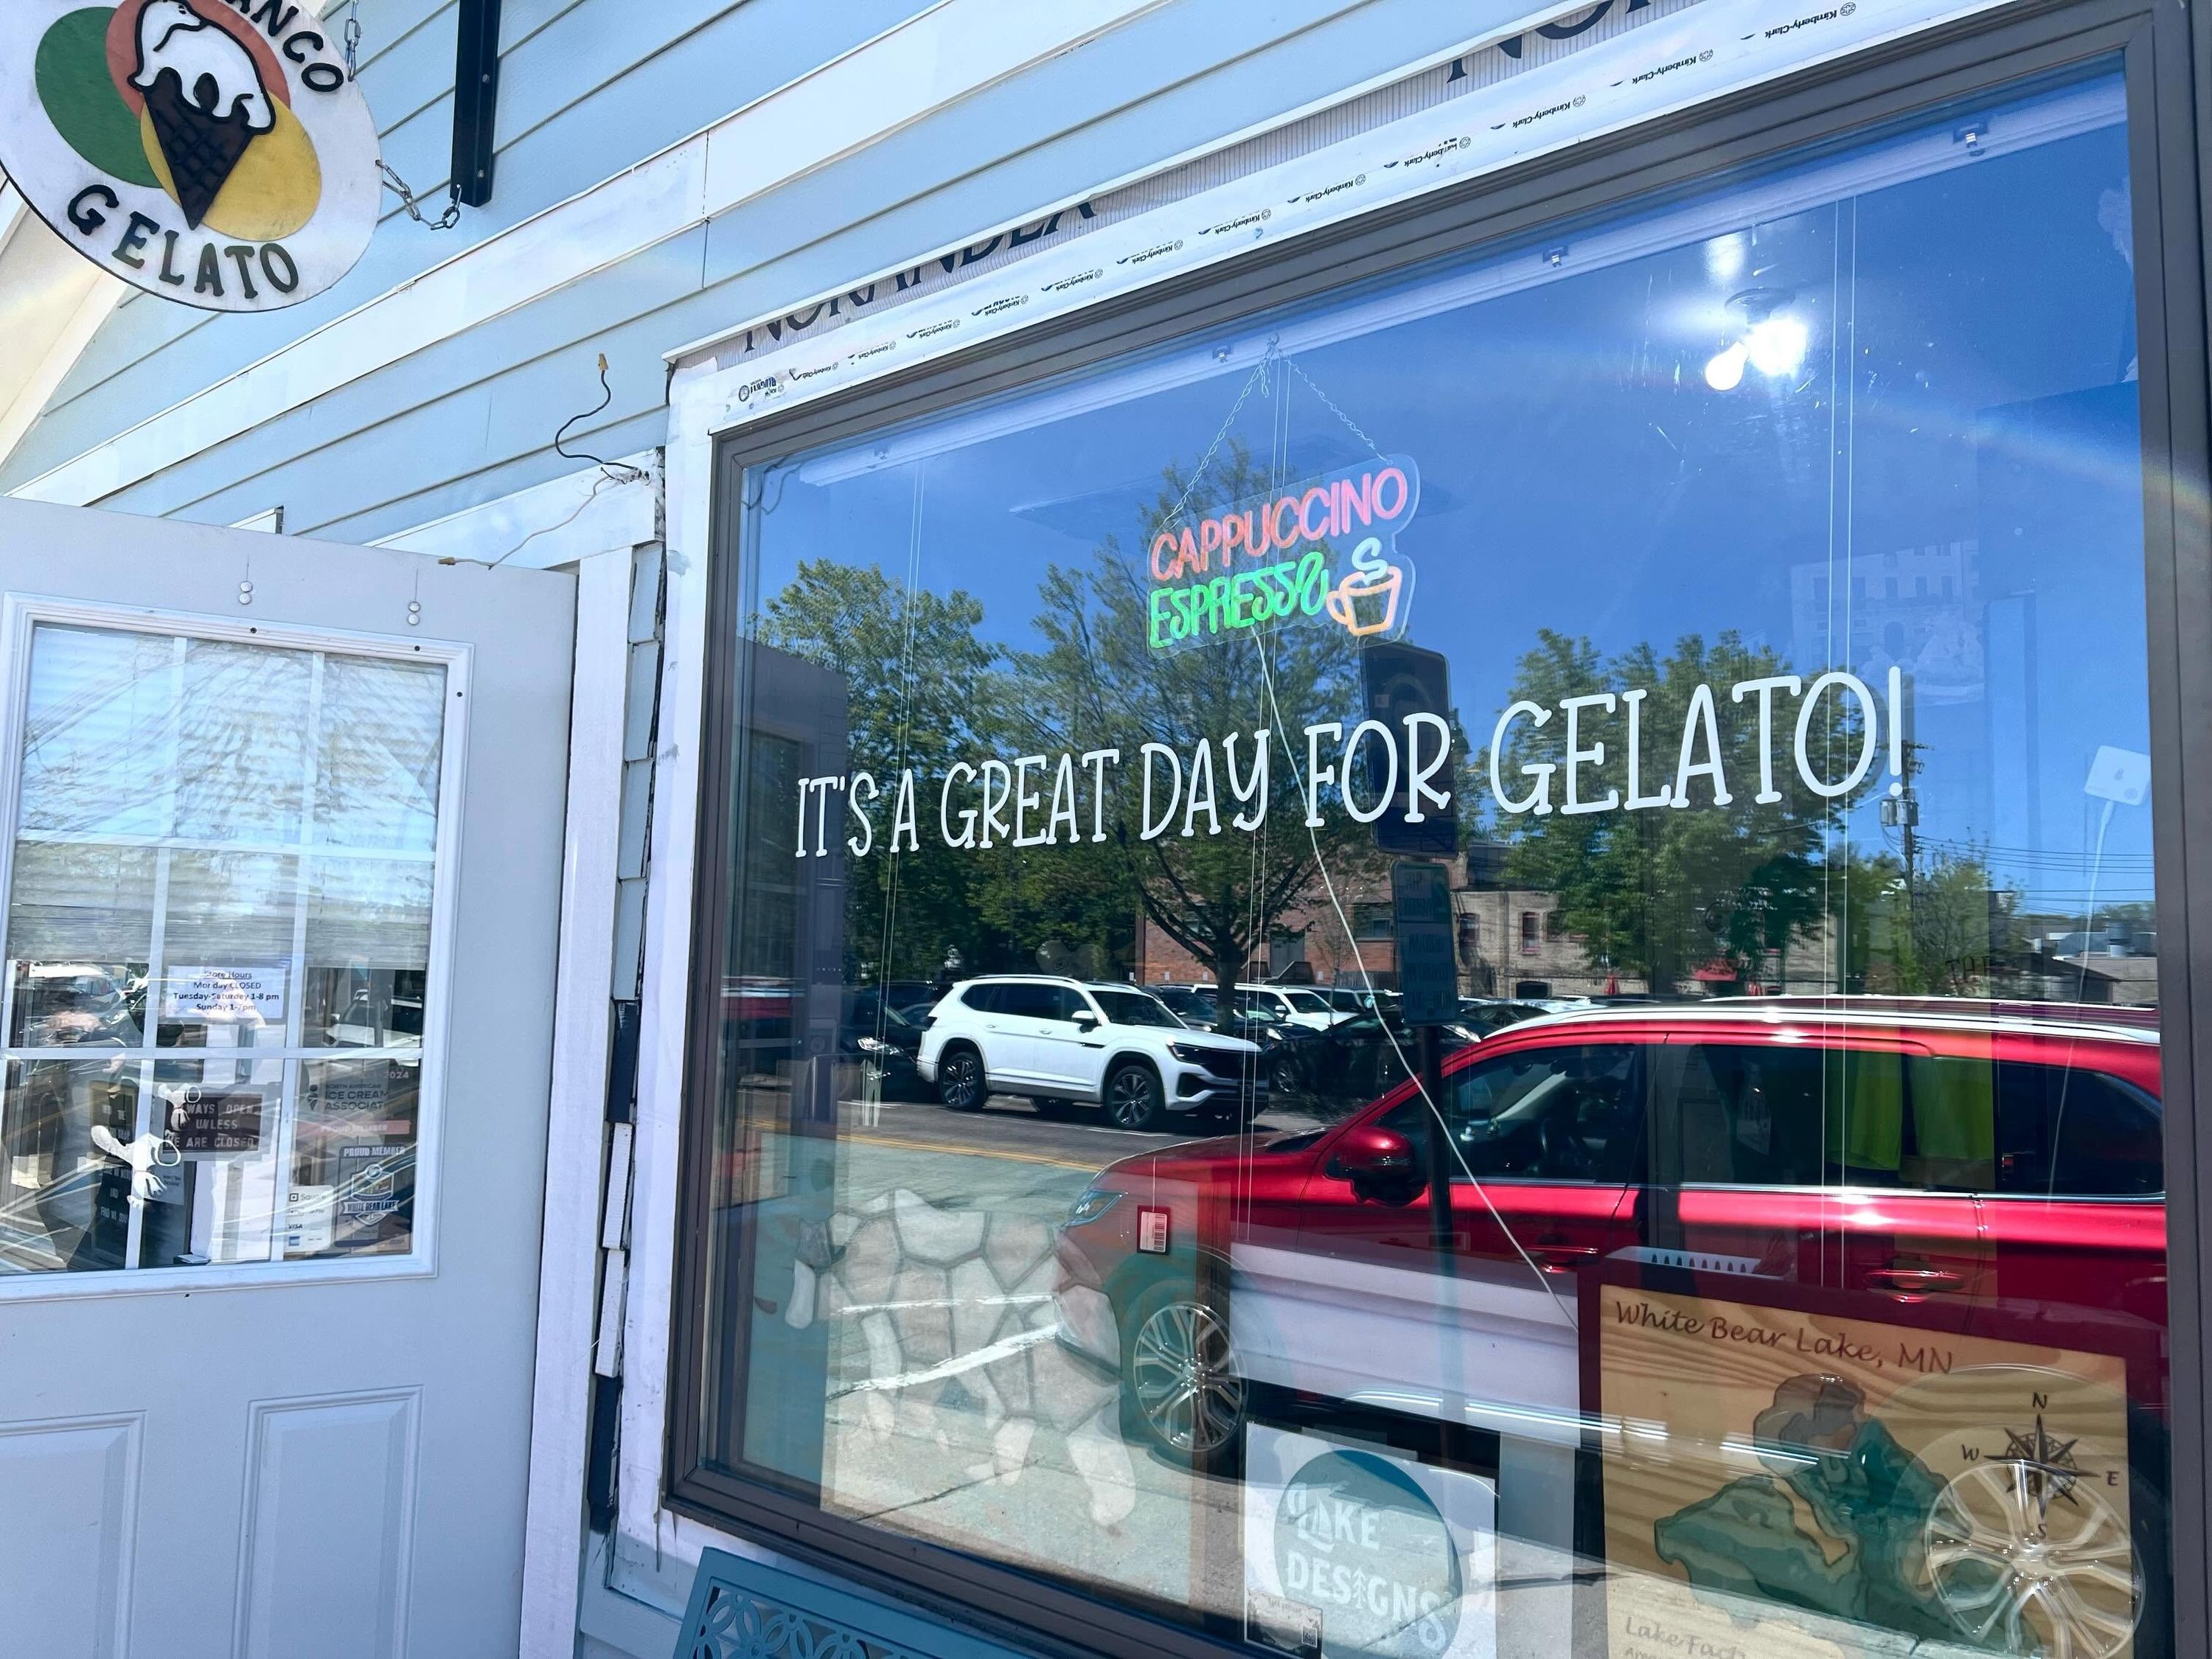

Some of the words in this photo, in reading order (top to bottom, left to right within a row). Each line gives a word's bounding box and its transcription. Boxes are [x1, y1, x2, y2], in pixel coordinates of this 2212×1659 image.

[1764, 10, 1837, 38] Kimberly-Clark
[1632, 55, 1697, 84] Kimberly-Clark
[1512, 102, 1571, 128] Kimberly-Clark
[1305, 180, 1354, 203] Kimberly-Clark
[1215, 214, 1260, 234] Kimberly-Clark
[67, 184, 299, 299] GELATO
[1132, 244, 1173, 265] Kimberly-Clark
[1151, 467, 1408, 581] CAPPUCCINO
[1149, 552, 1329, 649] ESPRESSO
[796, 771, 880, 858] IT'S
[890, 769, 920, 852] A
[941, 748, 1120, 849] GREAT
[1139, 728, 1270, 841] DAY
[1304, 712, 1452, 828] FOR
[1489, 665, 1904, 816] GELATO!
[204, 970, 226, 979] Store
[228, 970, 252, 979] Hours
[229, 981, 262, 990] CLOSED
[173, 992, 249, 1001] Tuesday-Saturday
[196, 1003, 228, 1012] Sunday
[383, 1071, 410, 1079] 2024
[325, 1091, 345, 1099] ICE
[347, 1091, 389, 1099] CREAM
[226, 1104, 254, 1114] OPEN
[324, 1101, 387, 1110] ASSOCIATI
[195, 1119, 240, 1130] UNLESS
[185, 1136, 208, 1147] ARE
[344, 1147, 370, 1157] PROUD
[371, 1147, 406, 1156] MEMBER
[1615, 1300, 1704, 1335] White
[1709, 1316, 1787, 1348] Bear
[1796, 1326, 1883, 1368] Lake,
[1898, 1342, 1953, 1375] MN
[2032, 1392, 2048, 1409] N
[1961, 1444, 1980, 1461] W
[2106, 1470, 2119, 1486] E
[1286, 1550, 1447, 1651] DESIGNS
[1625, 1615, 1684, 1646] Lake
